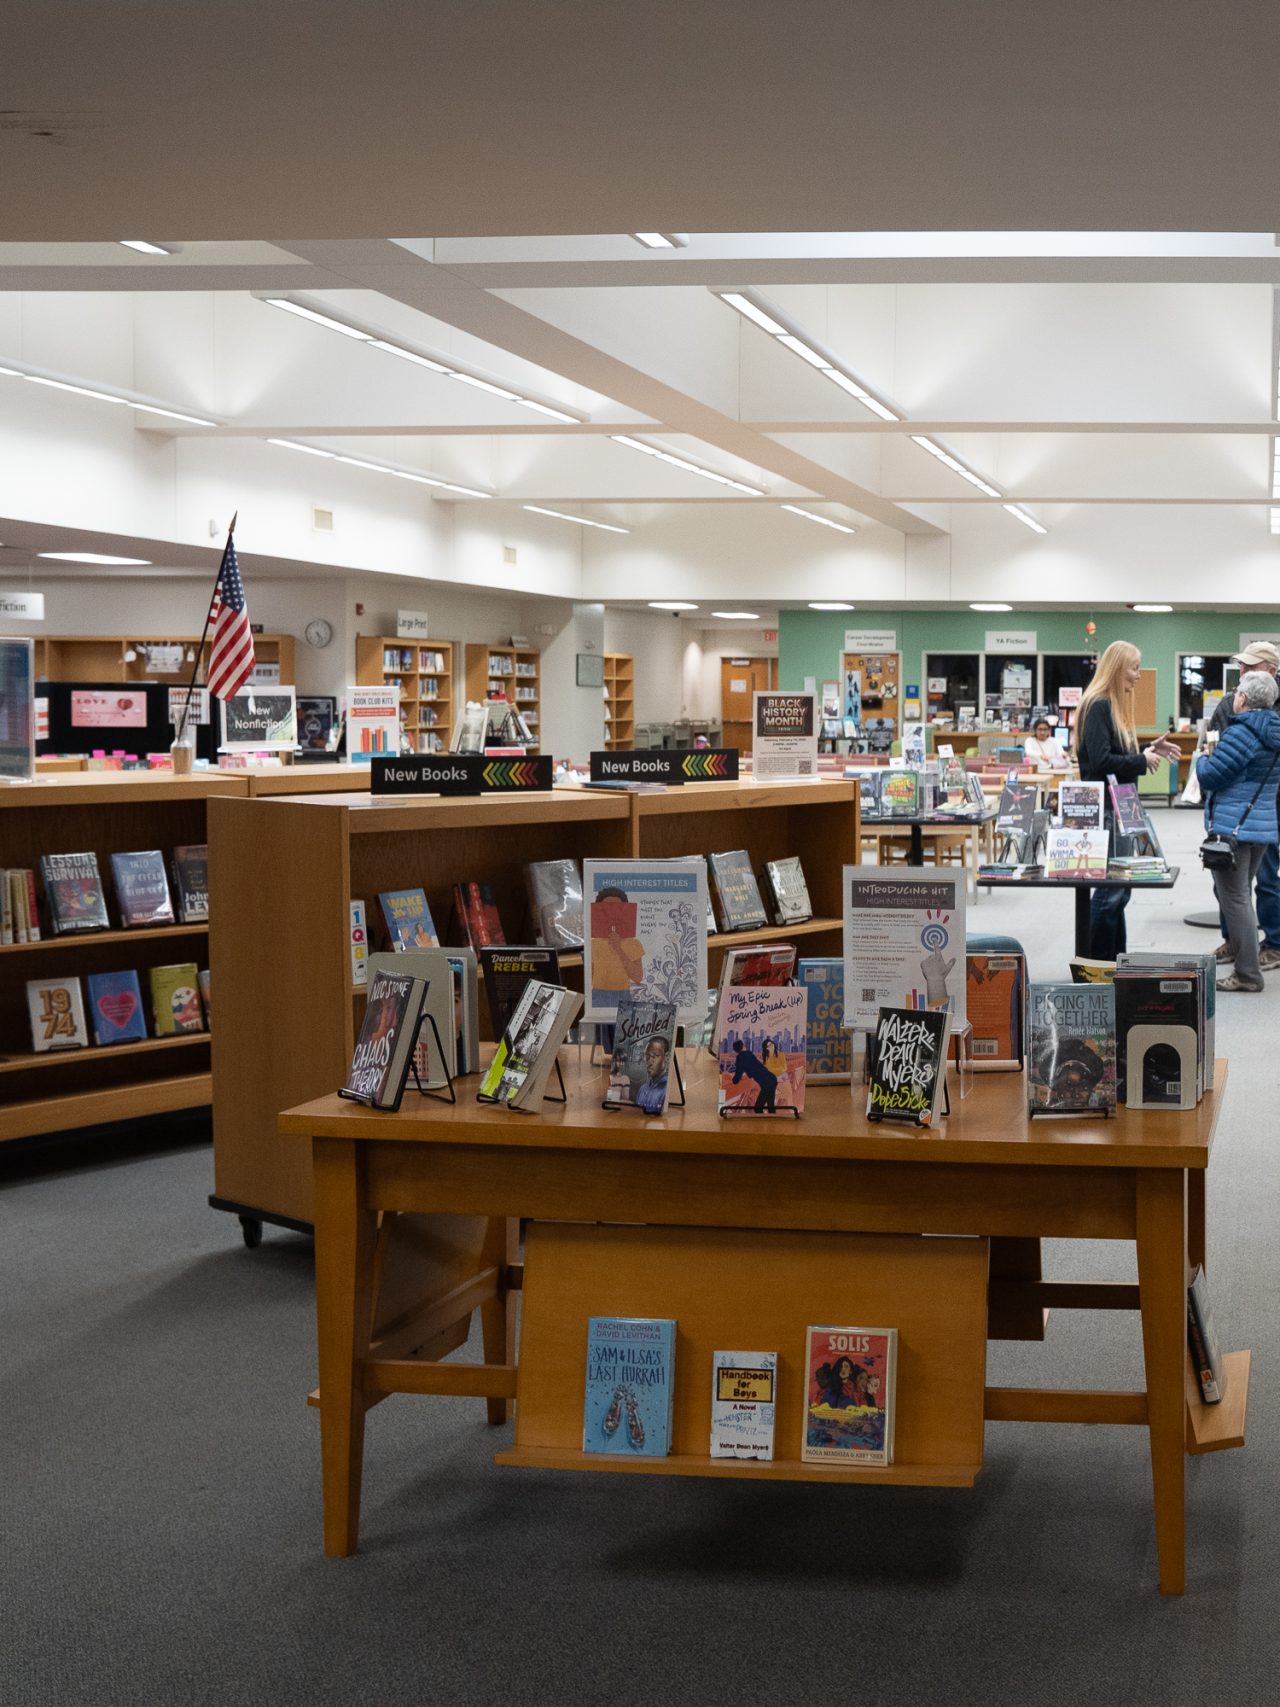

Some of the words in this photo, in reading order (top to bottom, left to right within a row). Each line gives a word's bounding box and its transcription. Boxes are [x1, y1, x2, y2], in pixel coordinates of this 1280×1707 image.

[398, 619, 413, 630] Large
[414, 619, 426, 629] Print
[353, 697, 367, 705] BOOK
[368, 697, 380, 705] CLUB
[381, 697, 393, 705] KITS
[768, 699, 801, 708] BLACK
[763, 708, 805, 717] HISTORY
[235, 718, 285, 729] Nonfiction
[765, 716, 803, 726] MONTH
[602, 761, 629, 774] New
[632, 759, 670, 772] Books
[384, 767, 419, 782] New
[422, 765, 468, 781] Books
[43, 852, 97, 868] LESSONS
[46, 867, 100, 881] SURVIVAL
[602, 879, 622, 887] HIGH
[624, 879, 660, 887] INTEREST
[663, 879, 688, 887] TITLES
[858, 884, 928, 896] INTRODUCING
[931, 887, 948, 896] HIT
[386, 894, 423, 909] WAKE
[886, 898, 917, 906] INTEREST
[352, 929, 365, 942] Q
[354, 946, 364, 960] 8
[493, 963, 538, 973] REBEL
[370, 981, 387, 1002] NIC
[385, 980, 410, 999] STONE
[729, 993, 748, 1009] My
[748, 990, 770, 1004] Epic
[1089, 994, 1109, 1010] ME
[727, 1007, 761, 1023] Spring
[758, 1000, 788, 1014] Break
[1035, 1010, 1109, 1027] TOGETHER
[618, 1012, 672, 1043] Schooled
[1086, 1026, 1107, 1036] Watson
[352, 1028, 395, 1070] CHAOS
[352, 1067, 388, 1093] THEORY
[597, 1323, 628, 1332] RACHEL
[630, 1324, 653, 1332] COHN
[596, 1330, 620, 1339] DAVID
[621, 1331, 661, 1340] LEVITHAN
[828, 1335, 870, 1352] SOLIS
[592, 1347, 618, 1364] SAM
[588, 1366, 617, 1382] LAST
[621, 1367, 665, 1387] HURRAH
[721, 1370, 769, 1381] Handbook
[737, 1380, 751, 1388] for
[733, 1388, 757, 1399] Boys
